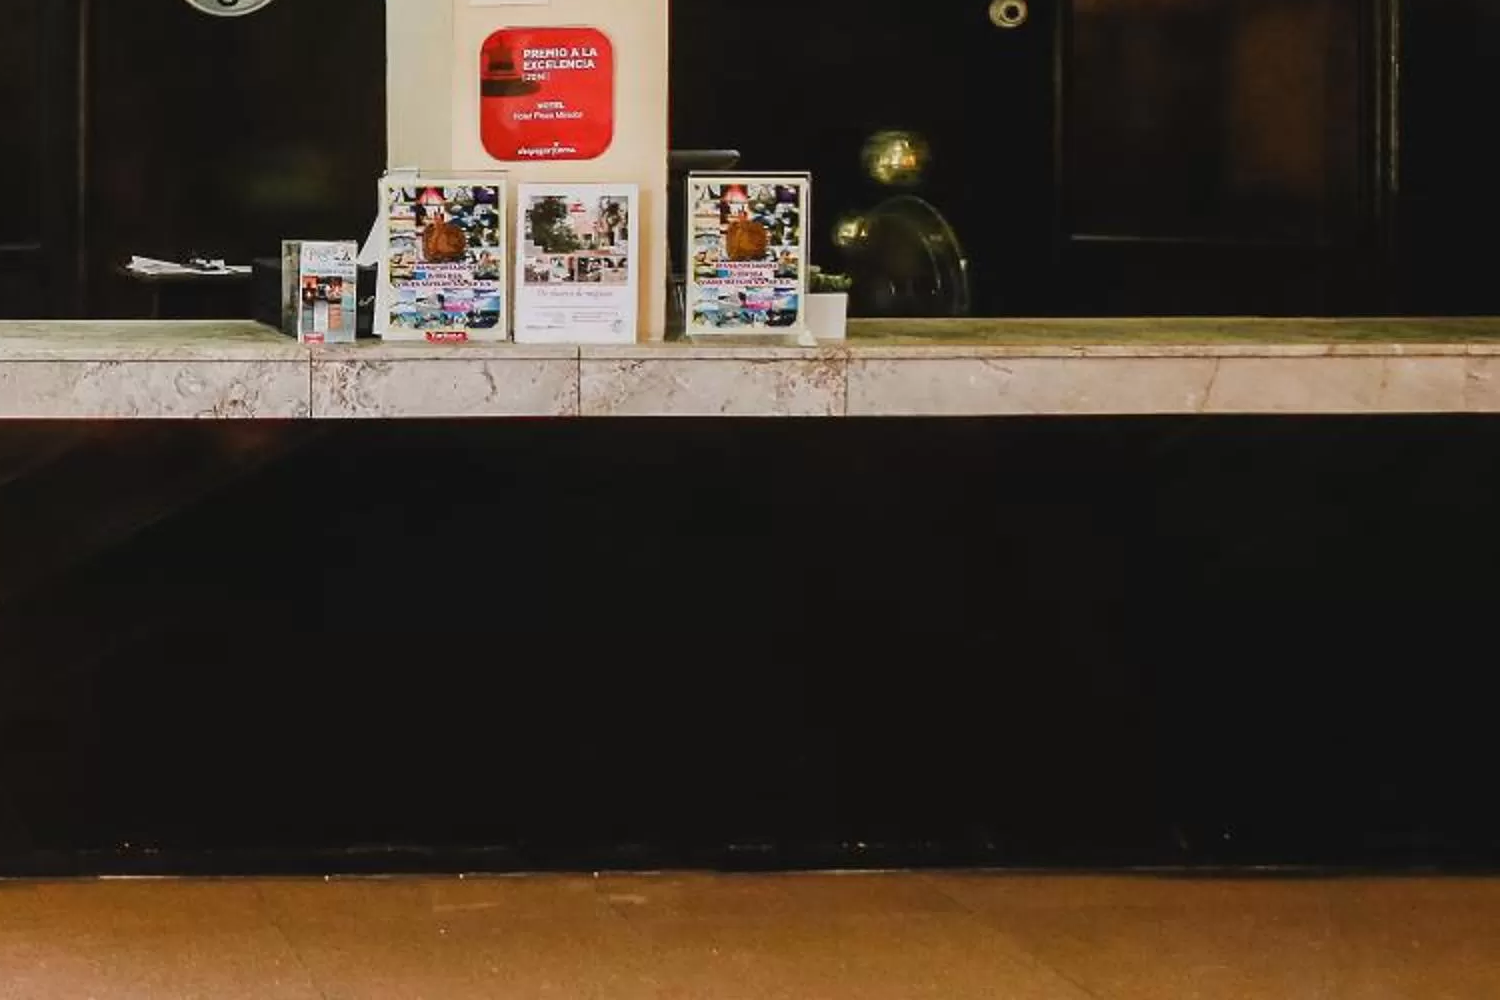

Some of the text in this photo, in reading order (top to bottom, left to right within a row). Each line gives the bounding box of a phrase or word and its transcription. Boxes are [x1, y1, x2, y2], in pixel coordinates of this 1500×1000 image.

[523, 47, 598, 59] PREMIO A LA
[523, 59, 596, 71] EXCELENCIA
